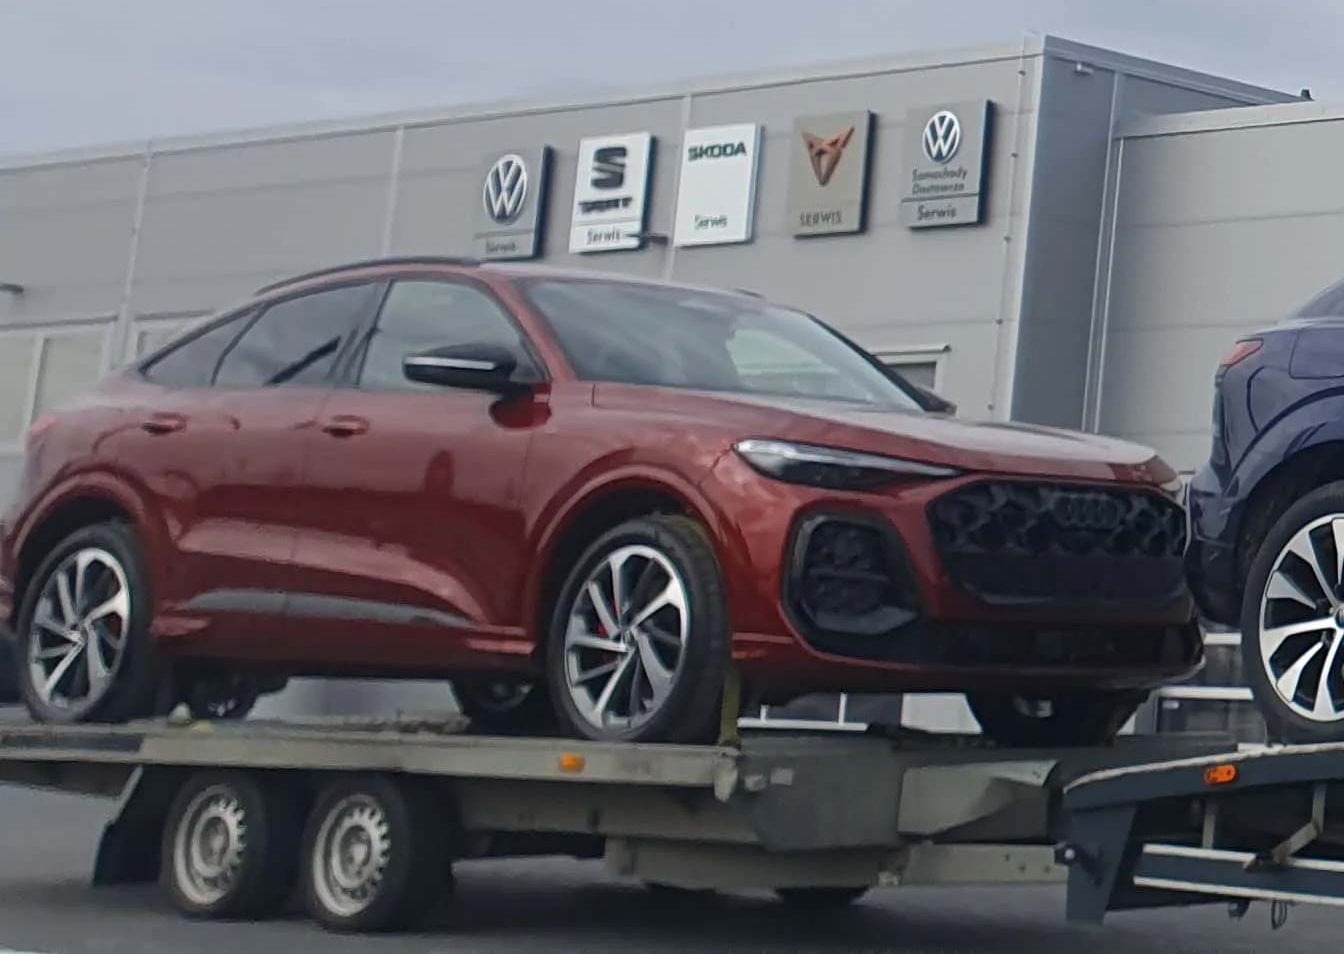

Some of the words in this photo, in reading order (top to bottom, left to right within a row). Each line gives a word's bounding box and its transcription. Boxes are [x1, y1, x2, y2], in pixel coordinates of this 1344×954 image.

[799, 209, 842, 227] SERWIS
[917, 204, 957, 221] Serwis
[586, 227, 621, 245] Serwis
